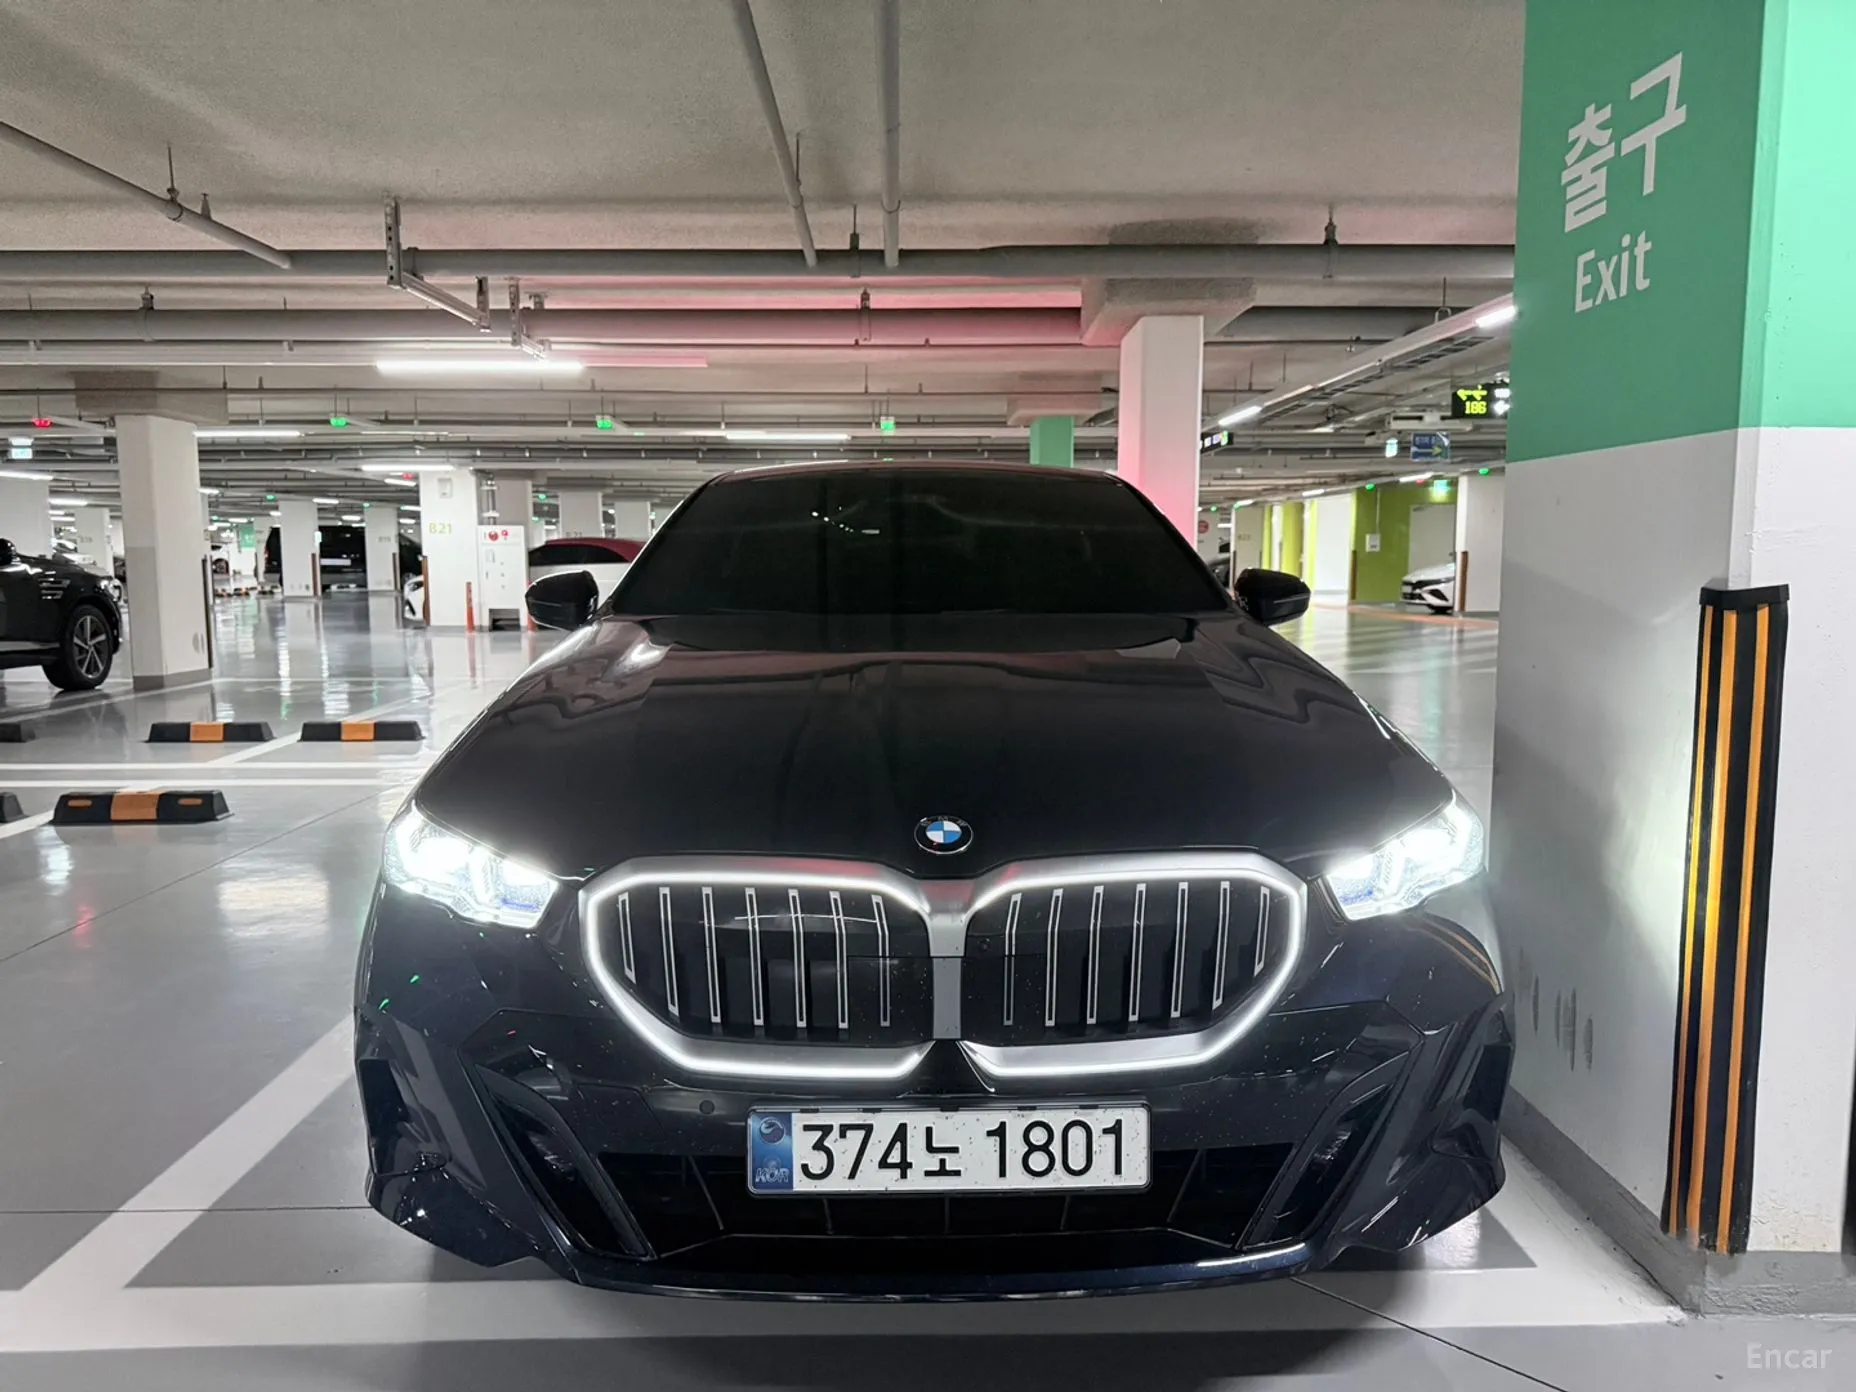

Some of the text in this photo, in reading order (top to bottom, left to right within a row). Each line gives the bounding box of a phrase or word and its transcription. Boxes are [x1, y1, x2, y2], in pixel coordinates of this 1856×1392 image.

[1560, 51, 1687, 233] 출구
[1574, 230, 1652, 313] Exit
[428, 522, 452, 534] B21
[801, 1118, 1123, 1181] 374노 1801
